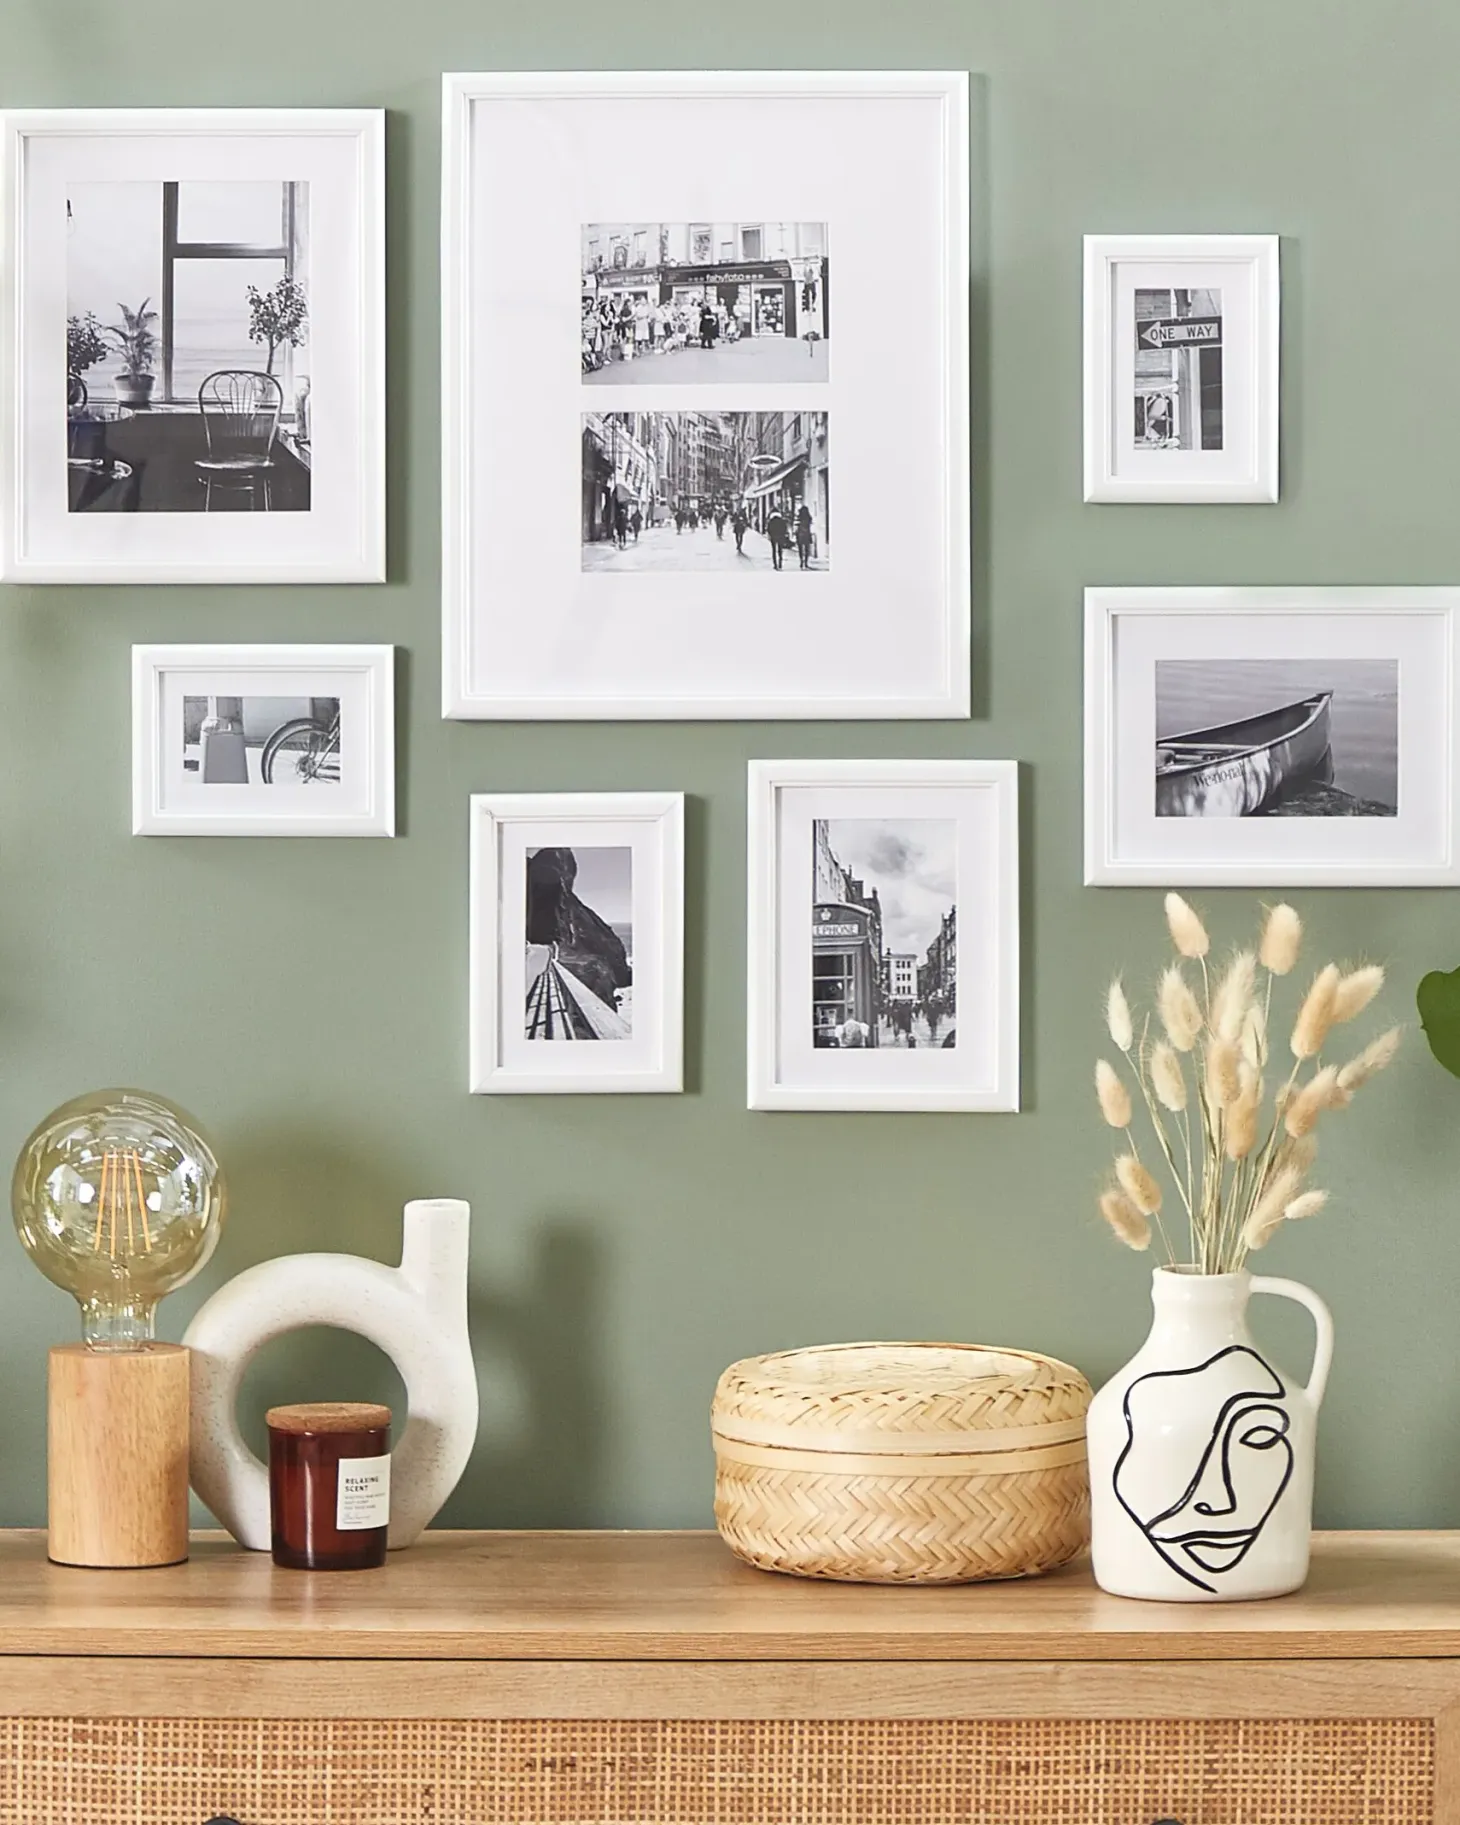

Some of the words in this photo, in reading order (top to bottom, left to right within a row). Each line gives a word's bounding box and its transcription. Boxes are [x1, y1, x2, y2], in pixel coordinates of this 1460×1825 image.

[1150, 328, 1176, 341] ONE
[1187, 325, 1213, 338] WAY
[345, 1476, 379, 1484] RELAXING
